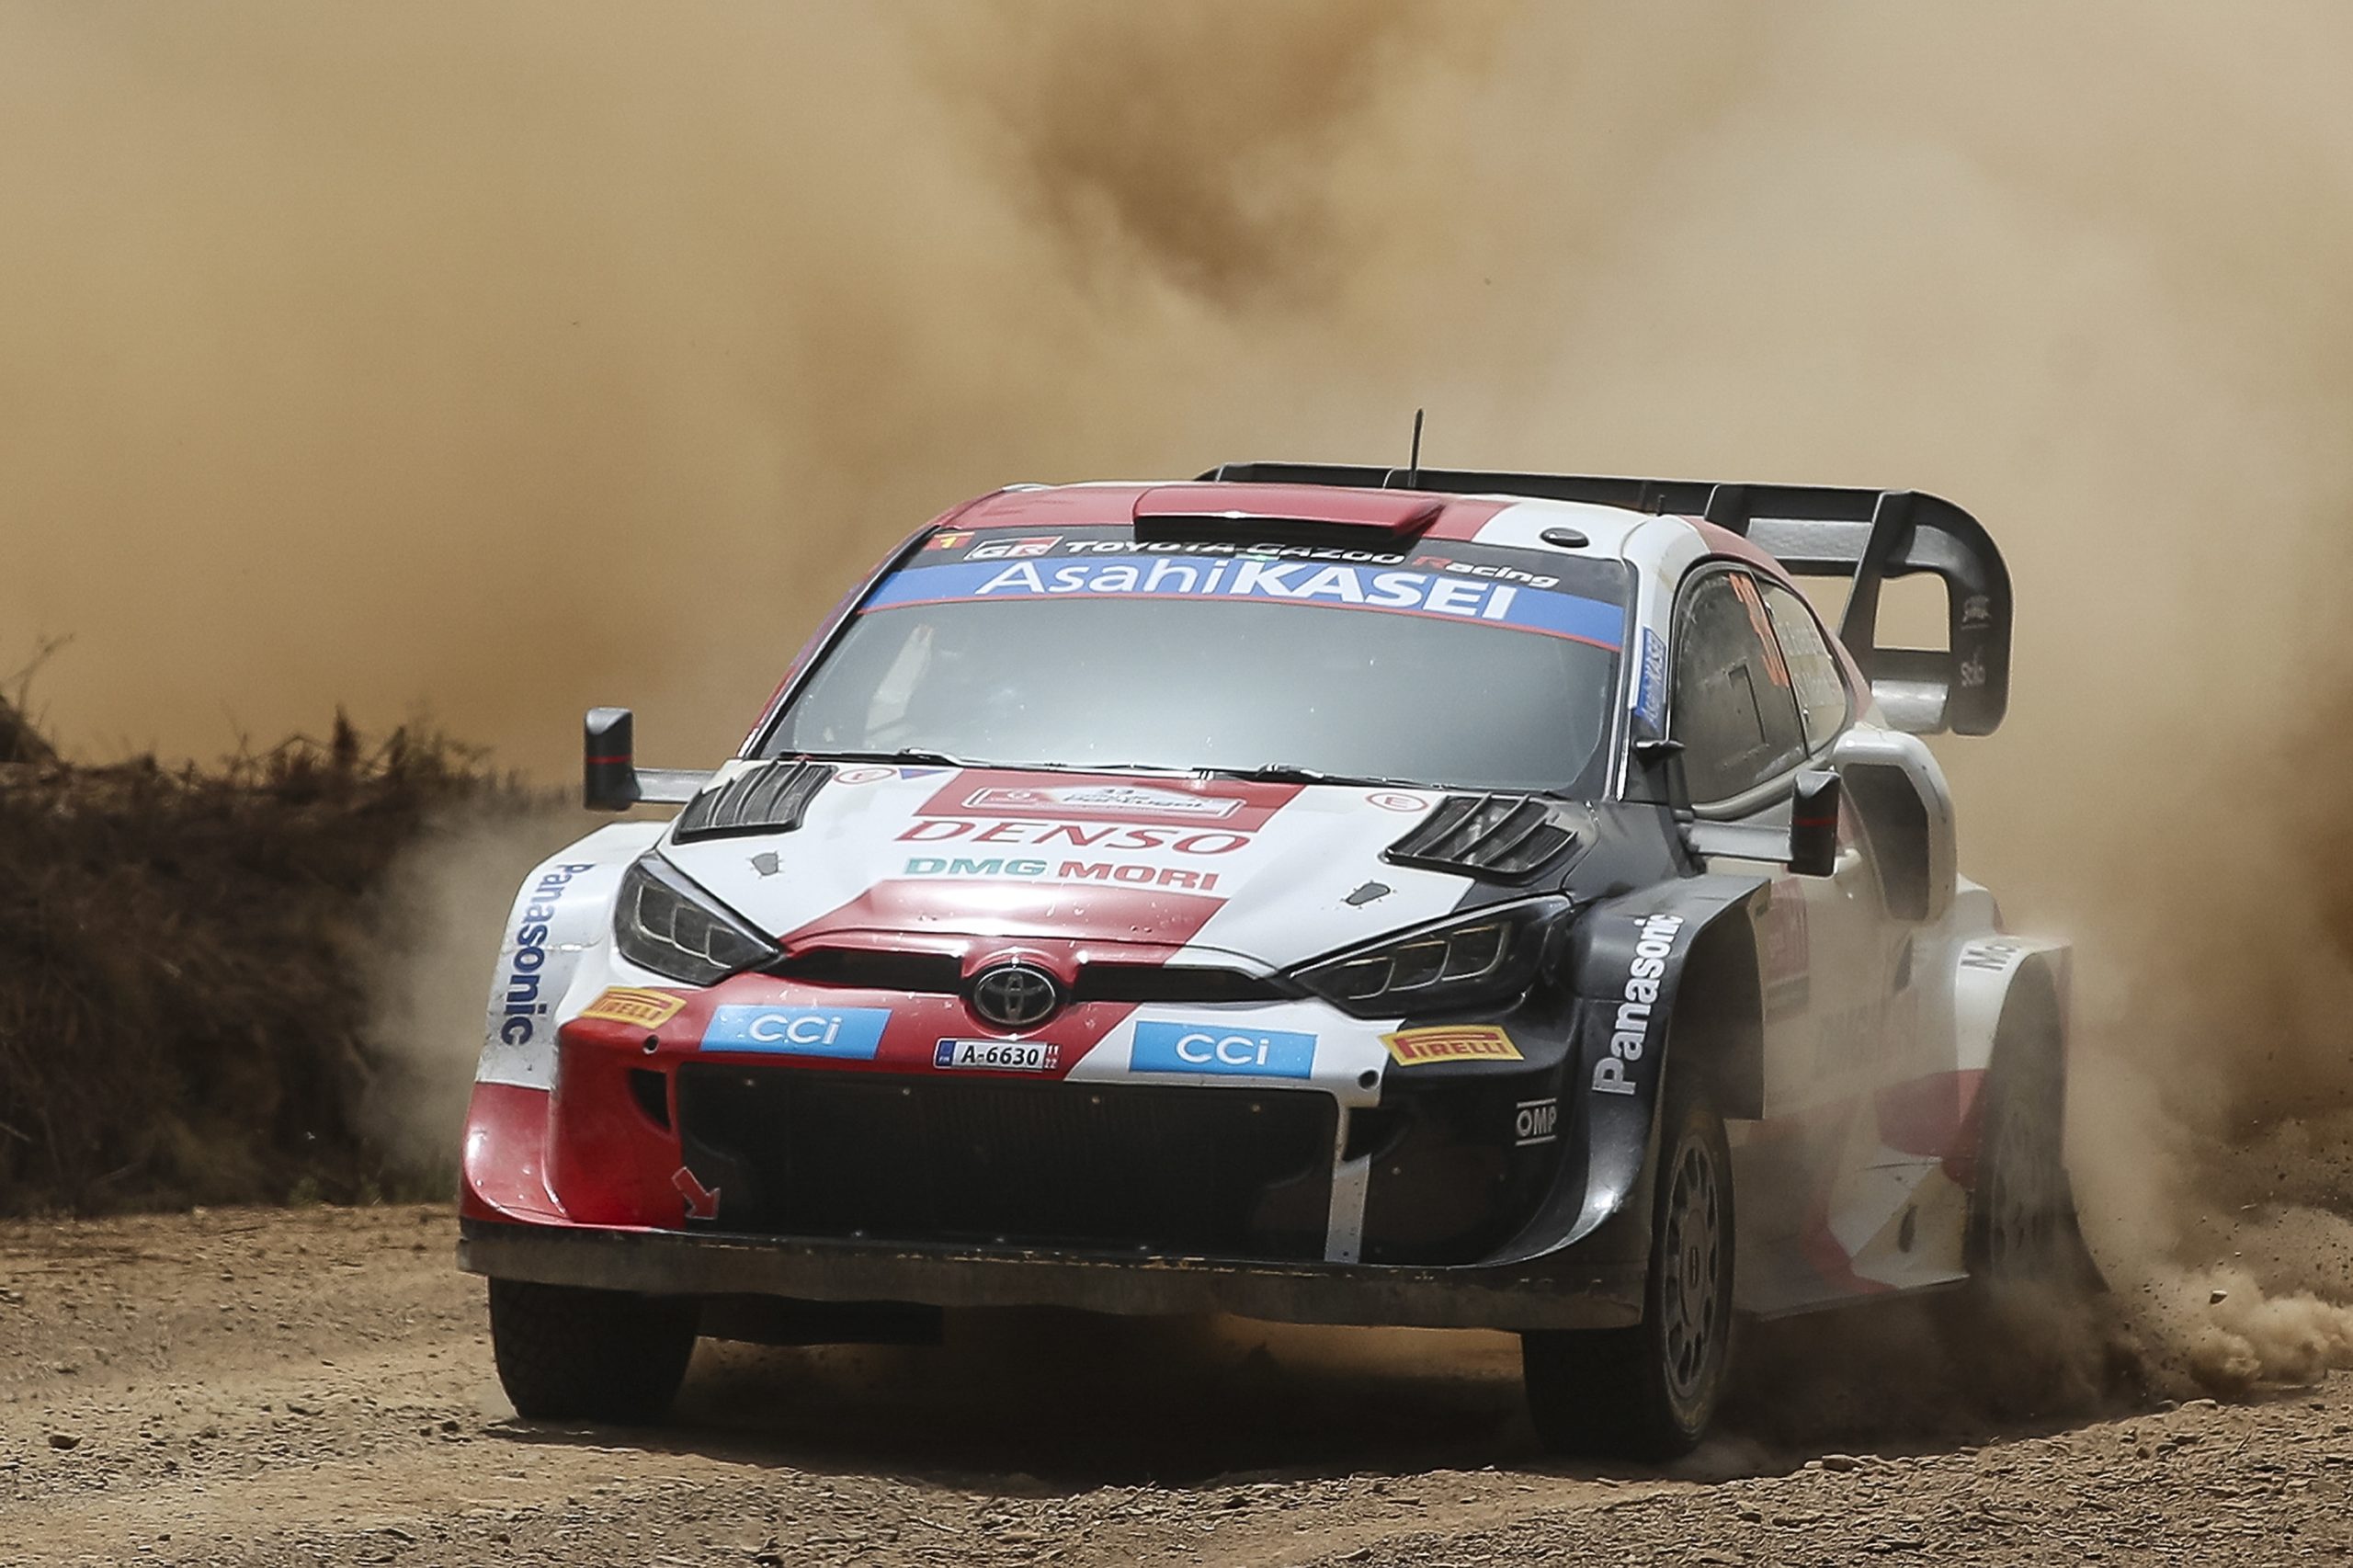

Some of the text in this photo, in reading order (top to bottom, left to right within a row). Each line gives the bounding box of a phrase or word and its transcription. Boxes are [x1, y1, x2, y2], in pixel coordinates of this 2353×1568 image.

[968, 540, 1560, 588] GR TOYOTA GAZOO Racing
[892, 820, 1252, 855] DENSO
[904, 857, 1221, 891] DMG MORI
[500, 863, 597, 1047] Panasonic
[961, 1045, 1040, 1066] A-6630
[1393, 1032, 1510, 1060] PIRELLI
[1517, 1105, 1558, 1137] OMP
